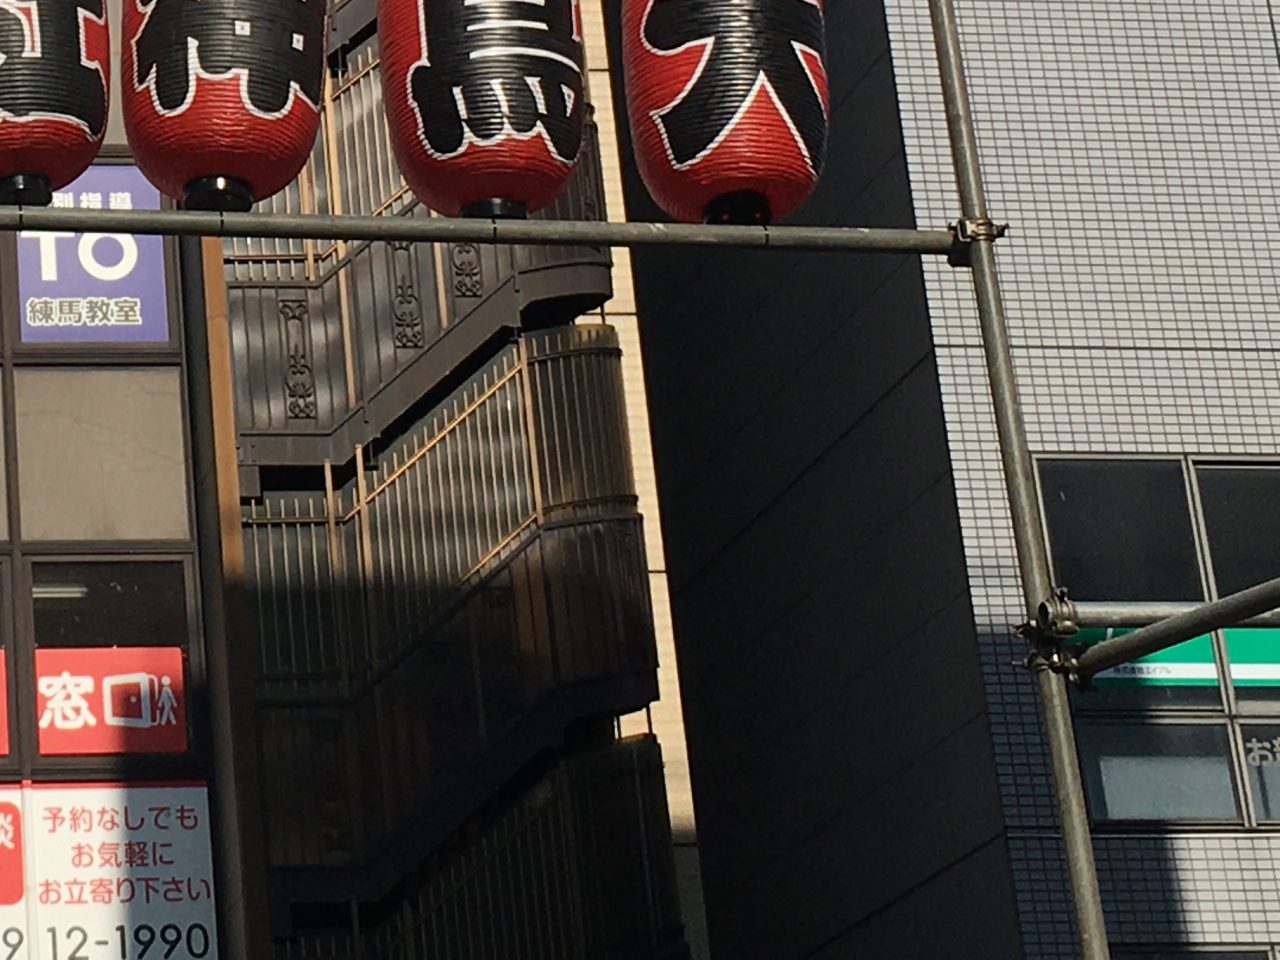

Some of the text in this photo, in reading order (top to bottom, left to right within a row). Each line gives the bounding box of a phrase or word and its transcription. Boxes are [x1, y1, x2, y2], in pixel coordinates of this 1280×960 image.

[26, 297, 142, 326] 練馬教室
[42, 804, 199, 833] 予約なしでも
[71, 841, 175, 868] お気軽に
[38, 876, 213, 906] お立寄り下さい
